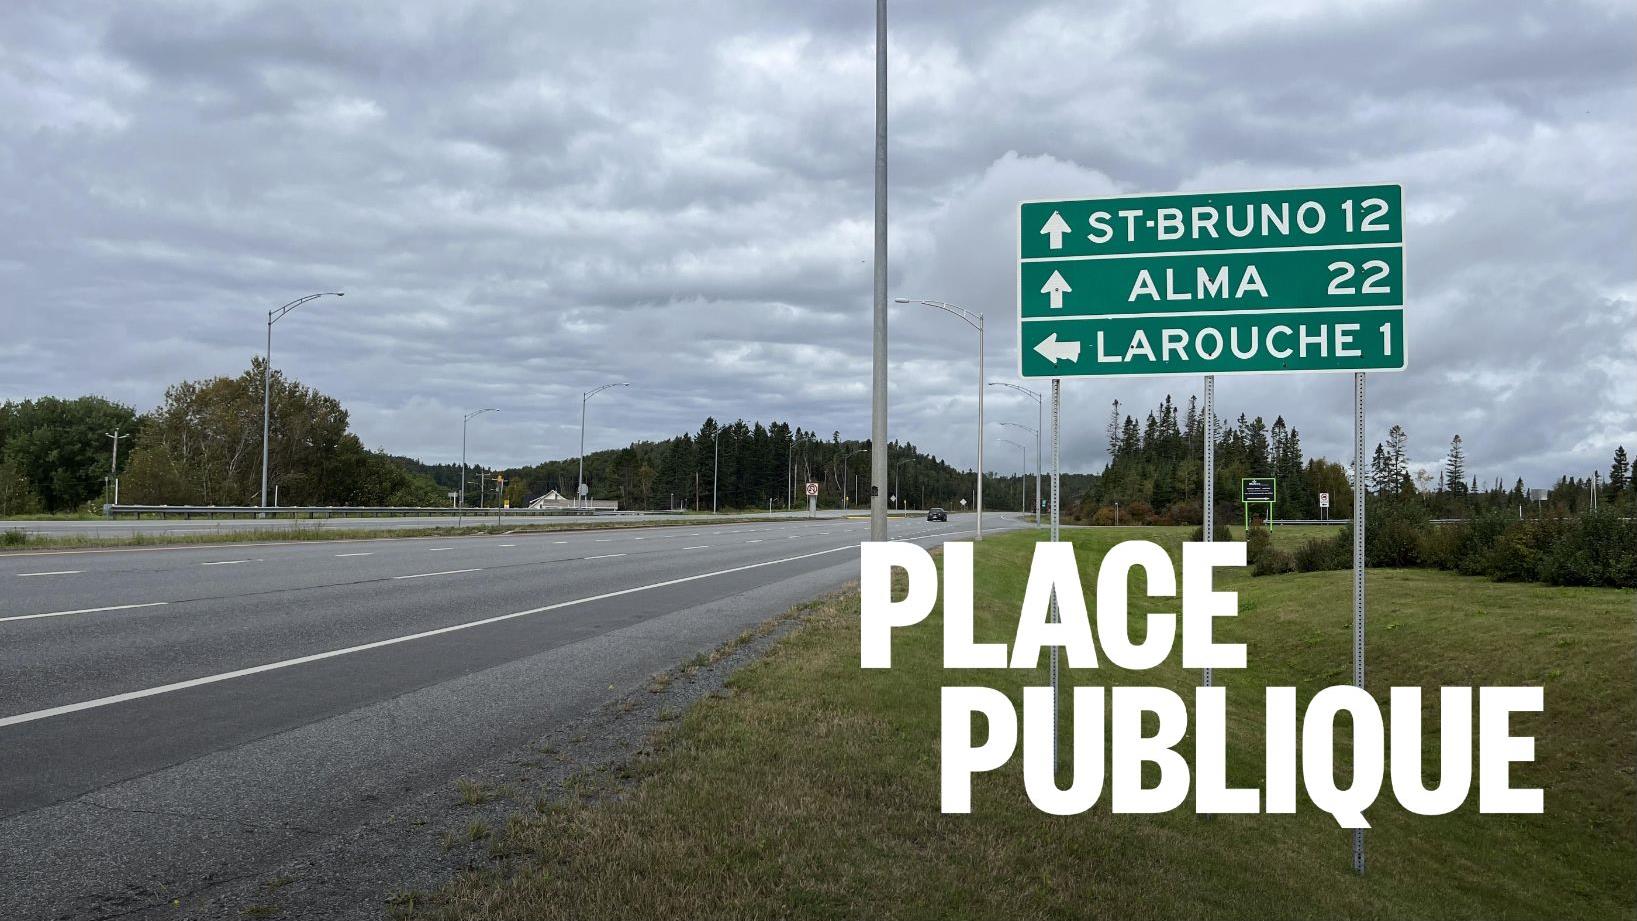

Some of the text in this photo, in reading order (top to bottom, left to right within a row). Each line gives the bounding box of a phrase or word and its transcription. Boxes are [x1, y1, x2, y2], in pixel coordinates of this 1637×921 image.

[1087, 198, 1390, 244] ST-BRUNO 12
[1128, 260, 1391, 302] ALMA 22
[1096, 322, 1391, 363] LAROUCHE 1
